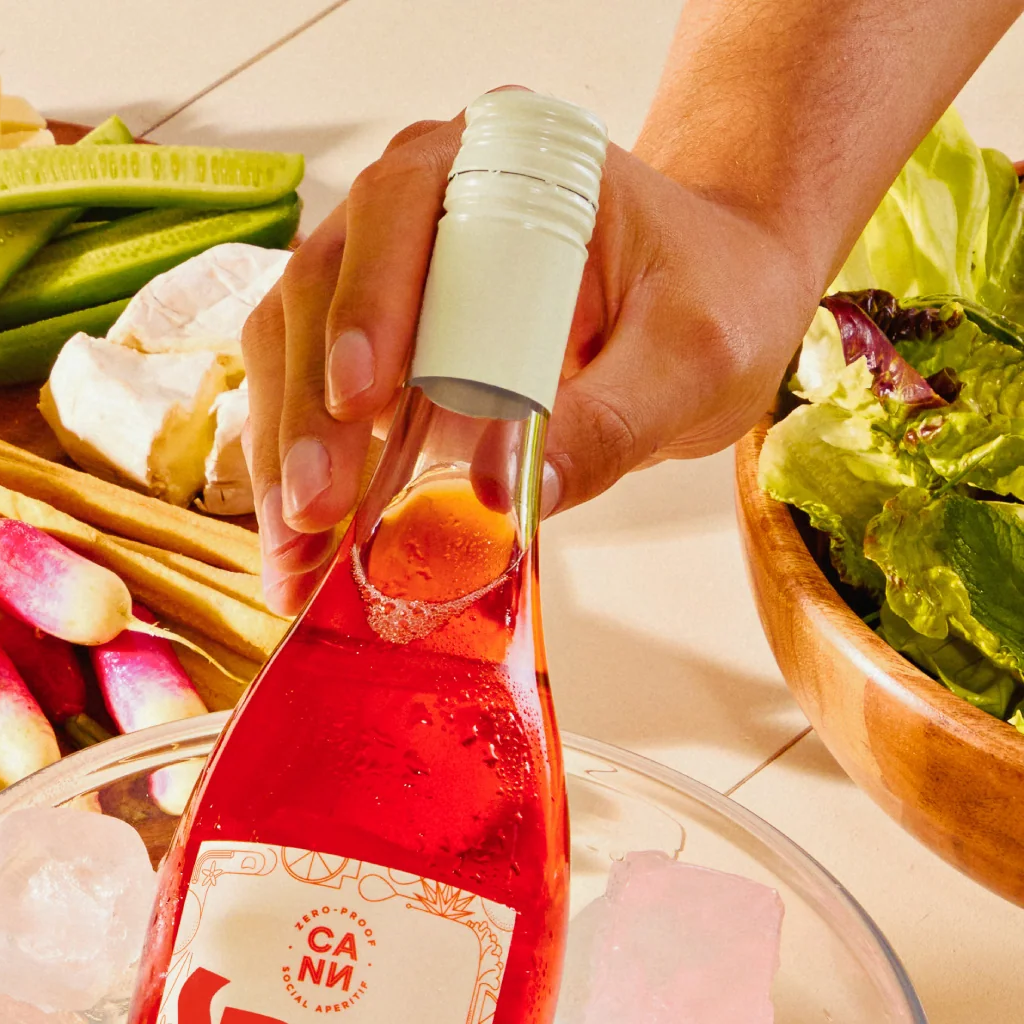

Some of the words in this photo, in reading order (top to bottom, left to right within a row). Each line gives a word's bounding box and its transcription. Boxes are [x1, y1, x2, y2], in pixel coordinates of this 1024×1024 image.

[294, 906, 376, 947] ZERO-PROOF
[282, 966, 308, 1008] SOCIAL
[315, 981, 368, 1013] APERITIF
